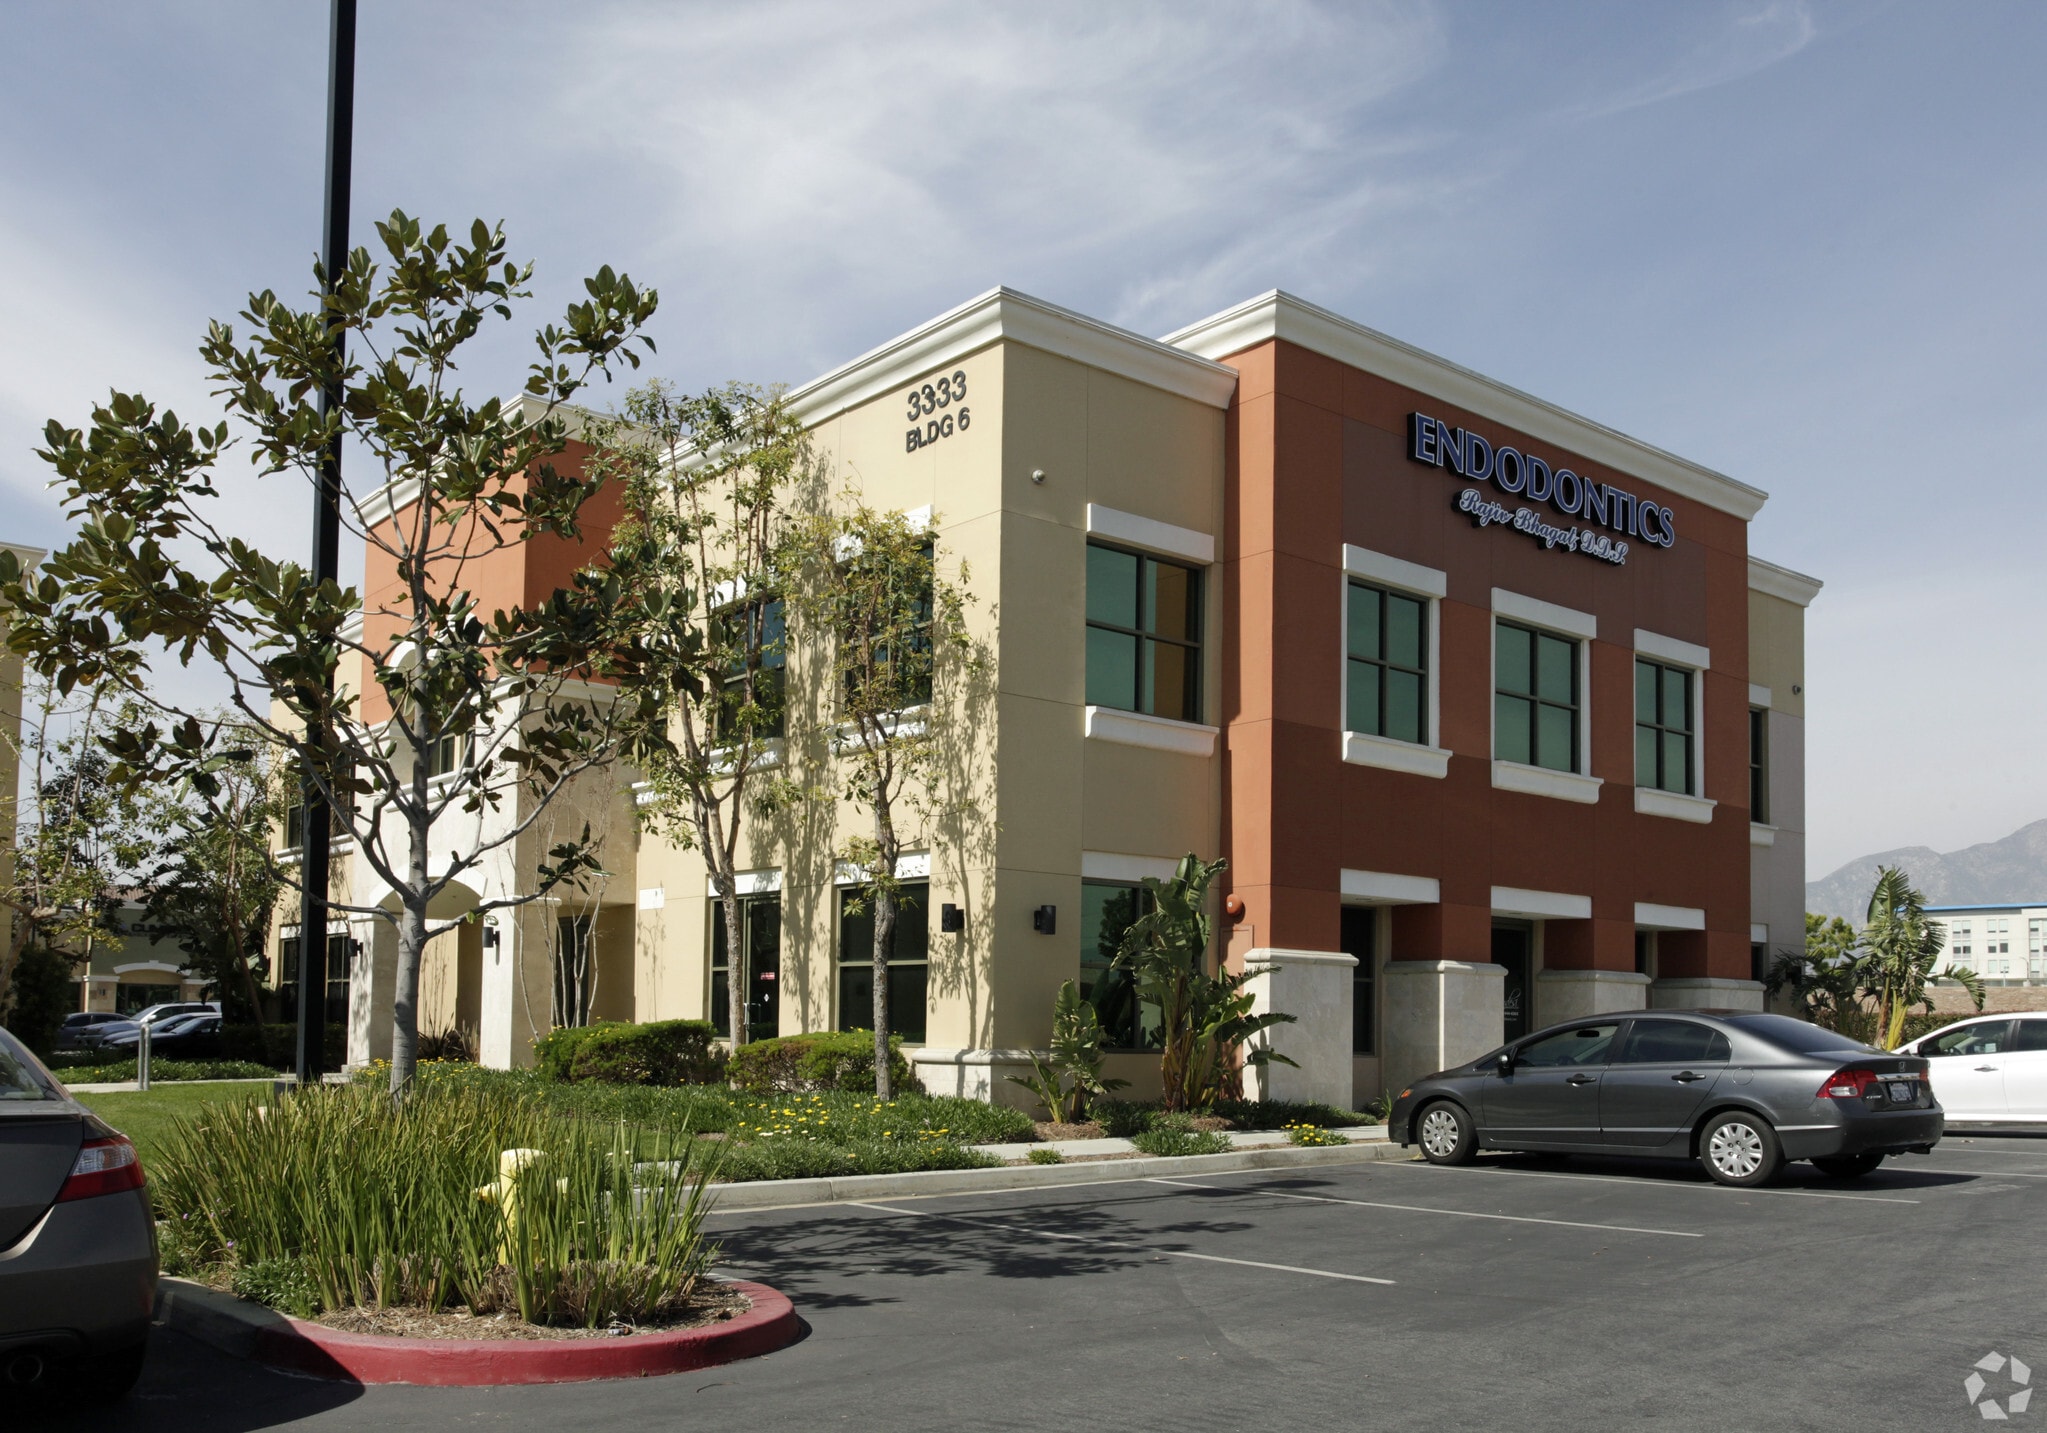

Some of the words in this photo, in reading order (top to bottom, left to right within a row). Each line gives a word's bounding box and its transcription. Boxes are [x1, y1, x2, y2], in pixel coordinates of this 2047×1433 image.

[907, 370, 967, 422] 3333
[905, 414, 954, 453] BLDG
[957, 406, 970, 431] 6
[1414, 411, 1676, 549] ENDODONTICS
[1459, 488, 1514, 527] Rajiv
[1513, 507, 1580, 551] Bhagat,
[1580, 529, 1629, 565] D.D.S.
